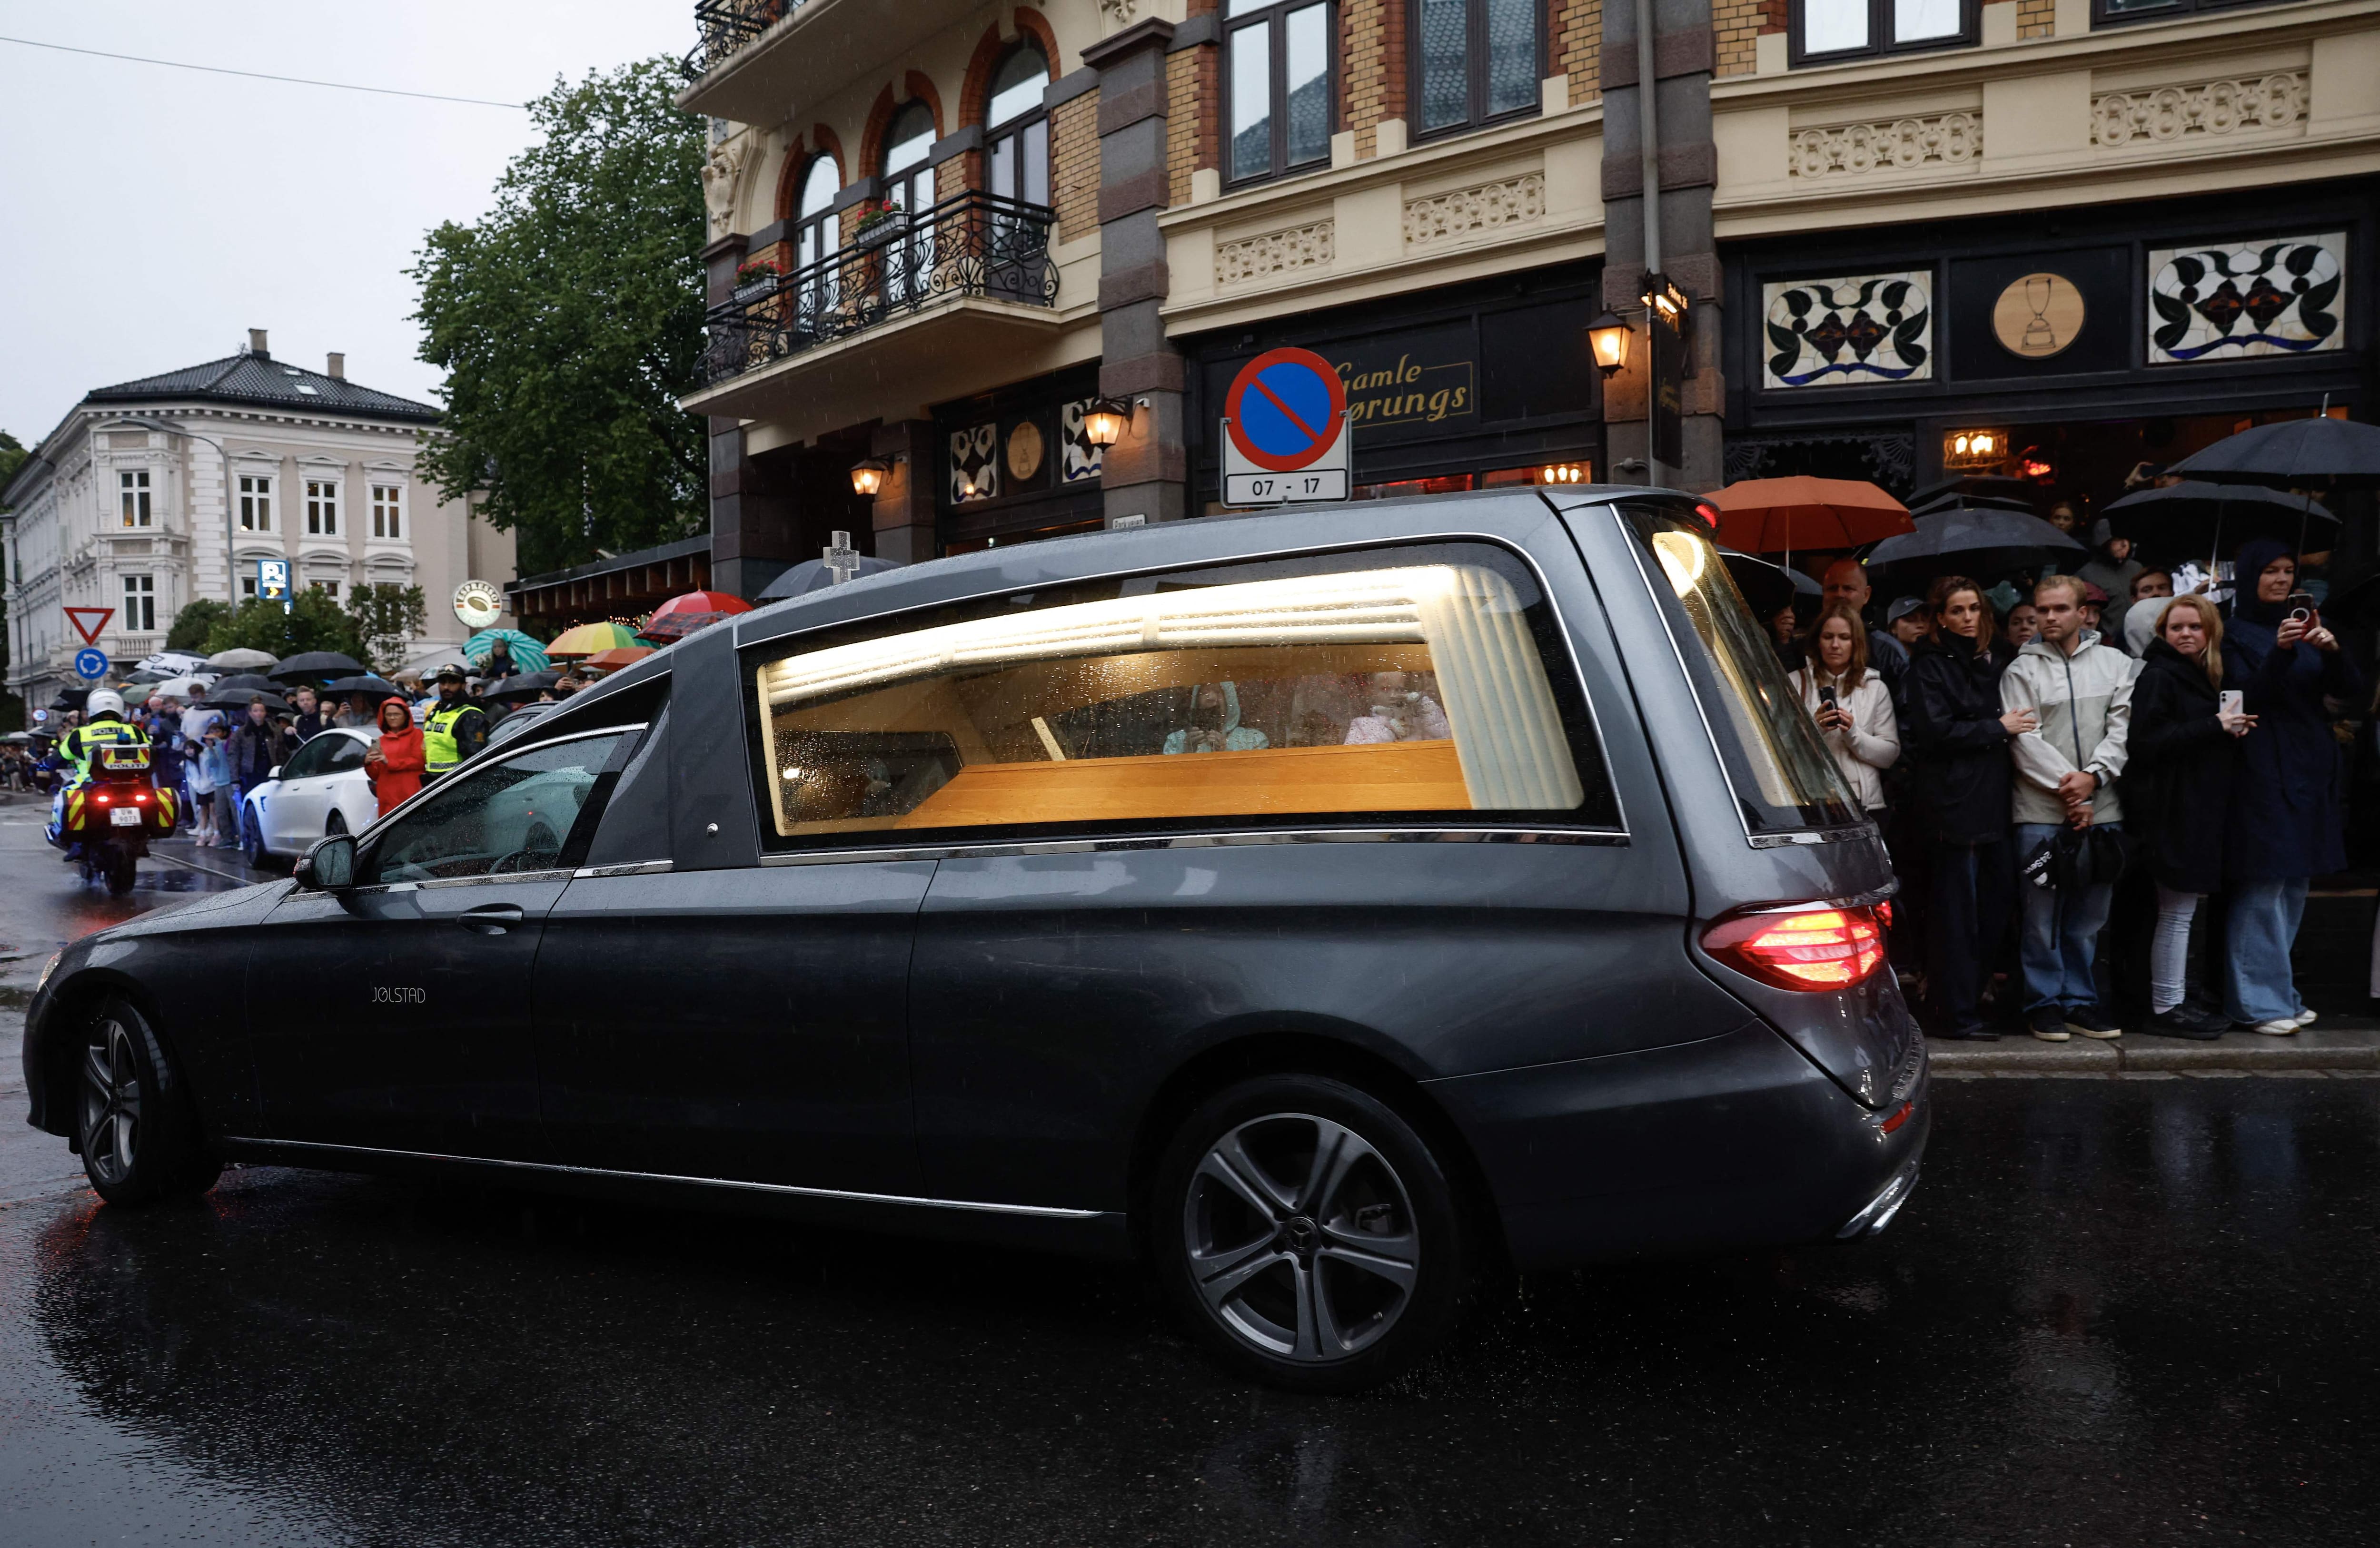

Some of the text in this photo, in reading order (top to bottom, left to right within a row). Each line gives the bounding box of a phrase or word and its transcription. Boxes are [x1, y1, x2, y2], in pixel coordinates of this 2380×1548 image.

[1350, 386, 1467, 422] ørungs
[1252, 481, 1274, 496] 07
[1304, 478, 1320, 493] 17
[457, 582, 498, 601] ESPRESSO
[462, 612, 496, 625] HOUSE
[372, 987, 426, 1003] JØLSTAD
